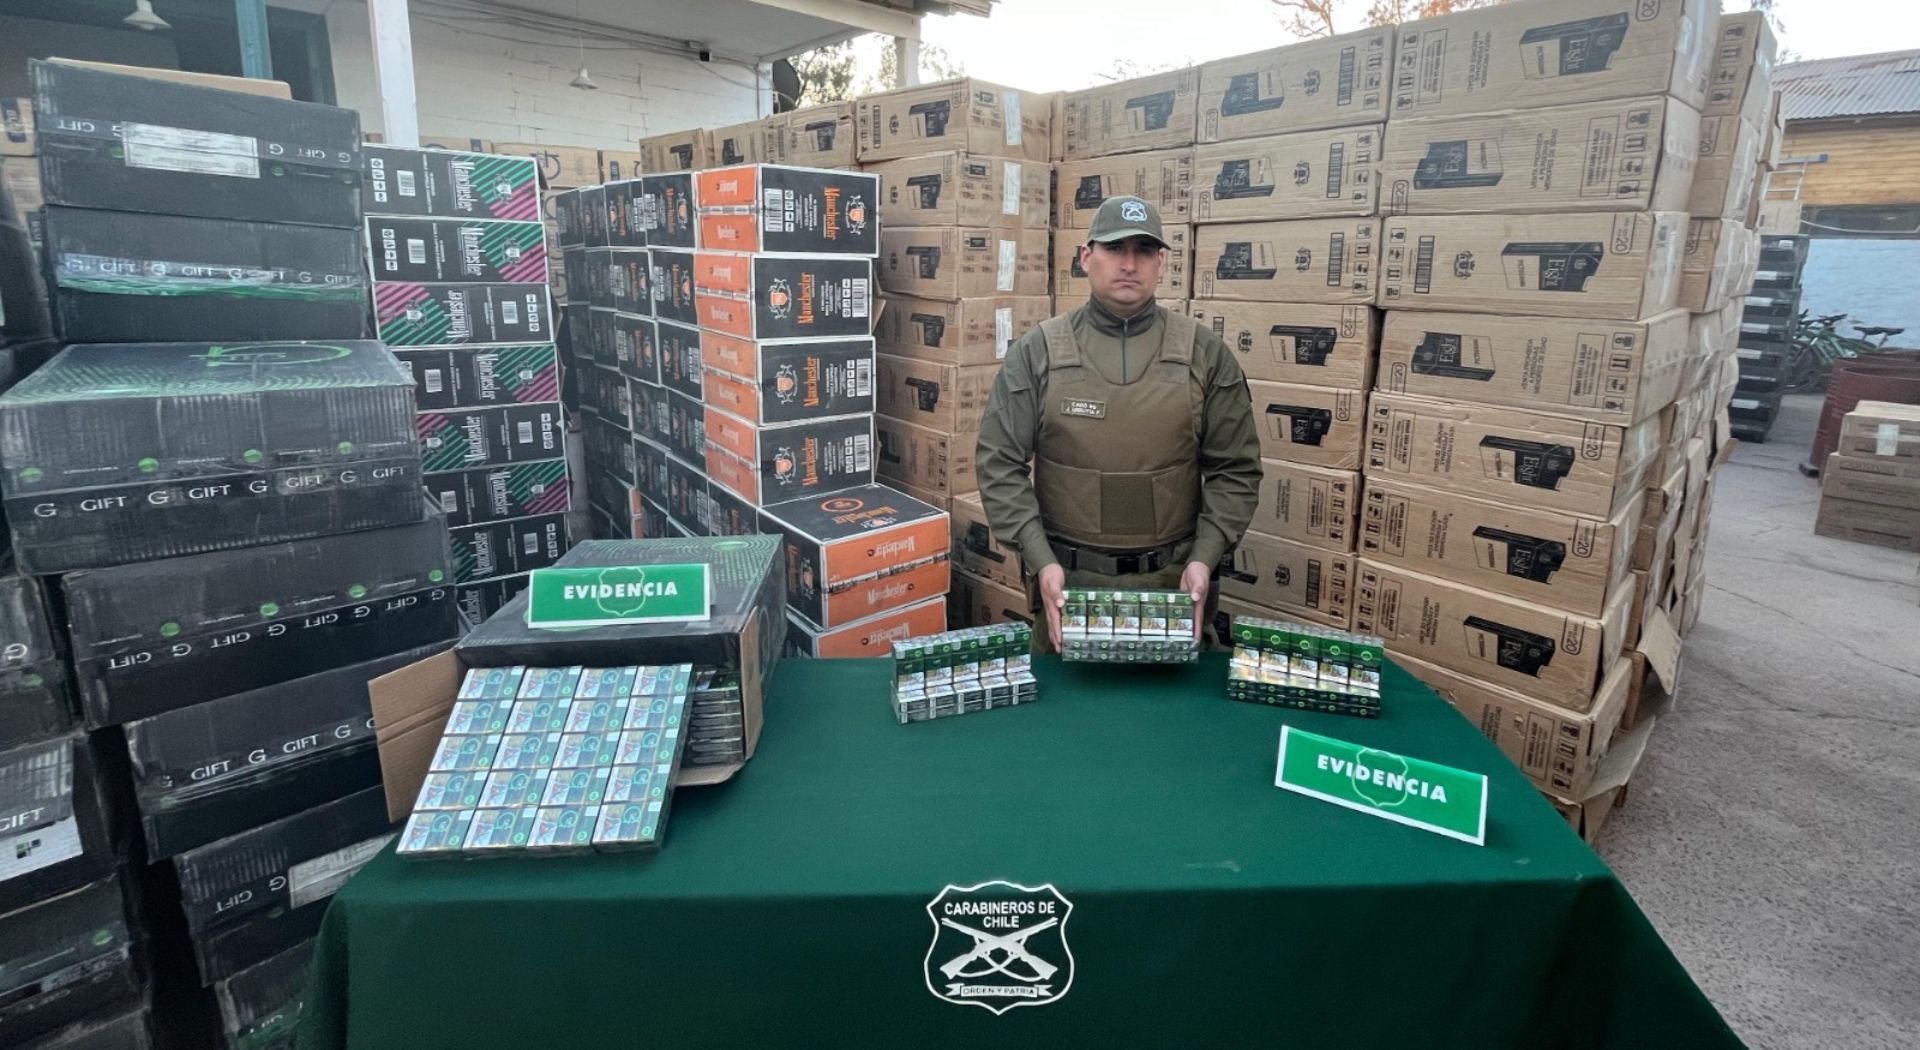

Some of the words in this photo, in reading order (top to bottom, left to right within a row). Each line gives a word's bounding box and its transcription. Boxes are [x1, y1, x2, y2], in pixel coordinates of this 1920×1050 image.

[1641, 2, 1656, 17] 20
[1569, 38, 1585, 71] Eight
[57, 119, 95, 133] GIFT
[269, 143, 284, 156] G
[296, 146, 326, 160] GIFT
[451, 160, 478, 211] Manchester
[824, 187, 841, 240] Manchester
[460, 227, 487, 276] Manchester
[1616, 237, 1627, 252] 20
[100, 261, 136, 273] GIFT
[181, 265, 214, 278] GIFT
[228, 268, 243, 280] G
[298, 271, 311, 283] G
[325, 273, 352, 285] GIFT
[1541, 258, 1566, 288] Eight
[798, 272, 813, 325] Manchester
[1439, 336, 1461, 363] Eight
[477, 353, 500, 400] Manchester
[803, 356, 819, 408] Manchester
[1338, 407, 1348, 419] 20
[464, 416, 487, 463] Manchester
[1586, 442, 1598, 458] 20
[802, 436, 818, 487] Manchester
[1521, 456, 1541, 485] Eight
[34, 503, 57, 518] G
[80, 495, 127, 513] GIFT
[147, 490, 169, 505] G
[188, 484, 231, 499] GIFT
[248, 479, 268, 494] G
[285, 474, 323, 488] GIFT
[340, 470, 357, 484] G
[372, 465, 406, 478] GIFT
[873, 535, 915, 559] Manchester
[1576, 542, 1591, 556] 20
[1516, 549, 1532, 576] Eight
[431, 589, 446, 600] G
[564, 581, 677, 600] EVIDENCIA
[868, 581, 908, 605] Manchester
[354, 605, 370, 618] G
[385, 596, 417, 611] GIFT
[304, 613, 339, 628] GIFT
[267, 623, 286, 637] G
[868, 622, 910, 646] Manchester
[211, 631, 250, 648] GIFT
[1565, 639, 1578, 652] 20
[4, 643, 27, 660] G
[171, 643, 191, 657] G
[106, 652, 151, 669] GIFT
[191, 758, 231, 782] GIFT
[248, 749, 267, 764] G
[282, 733, 320, 754] GIFT
[335, 724, 351, 739] G
[1317, 754, 1447, 803] EVIDENCIA
[268, 875, 287, 891] G
[215, 889, 253, 914] GIFT
[944, 902, 1035, 915] CARABINEROS
[1038, 901, 1055, 913] DE
[983, 916, 1019, 928] CHILE
[963, 985, 995, 995] ORDEN
[1004, 986, 1035, 995] PATRIA
